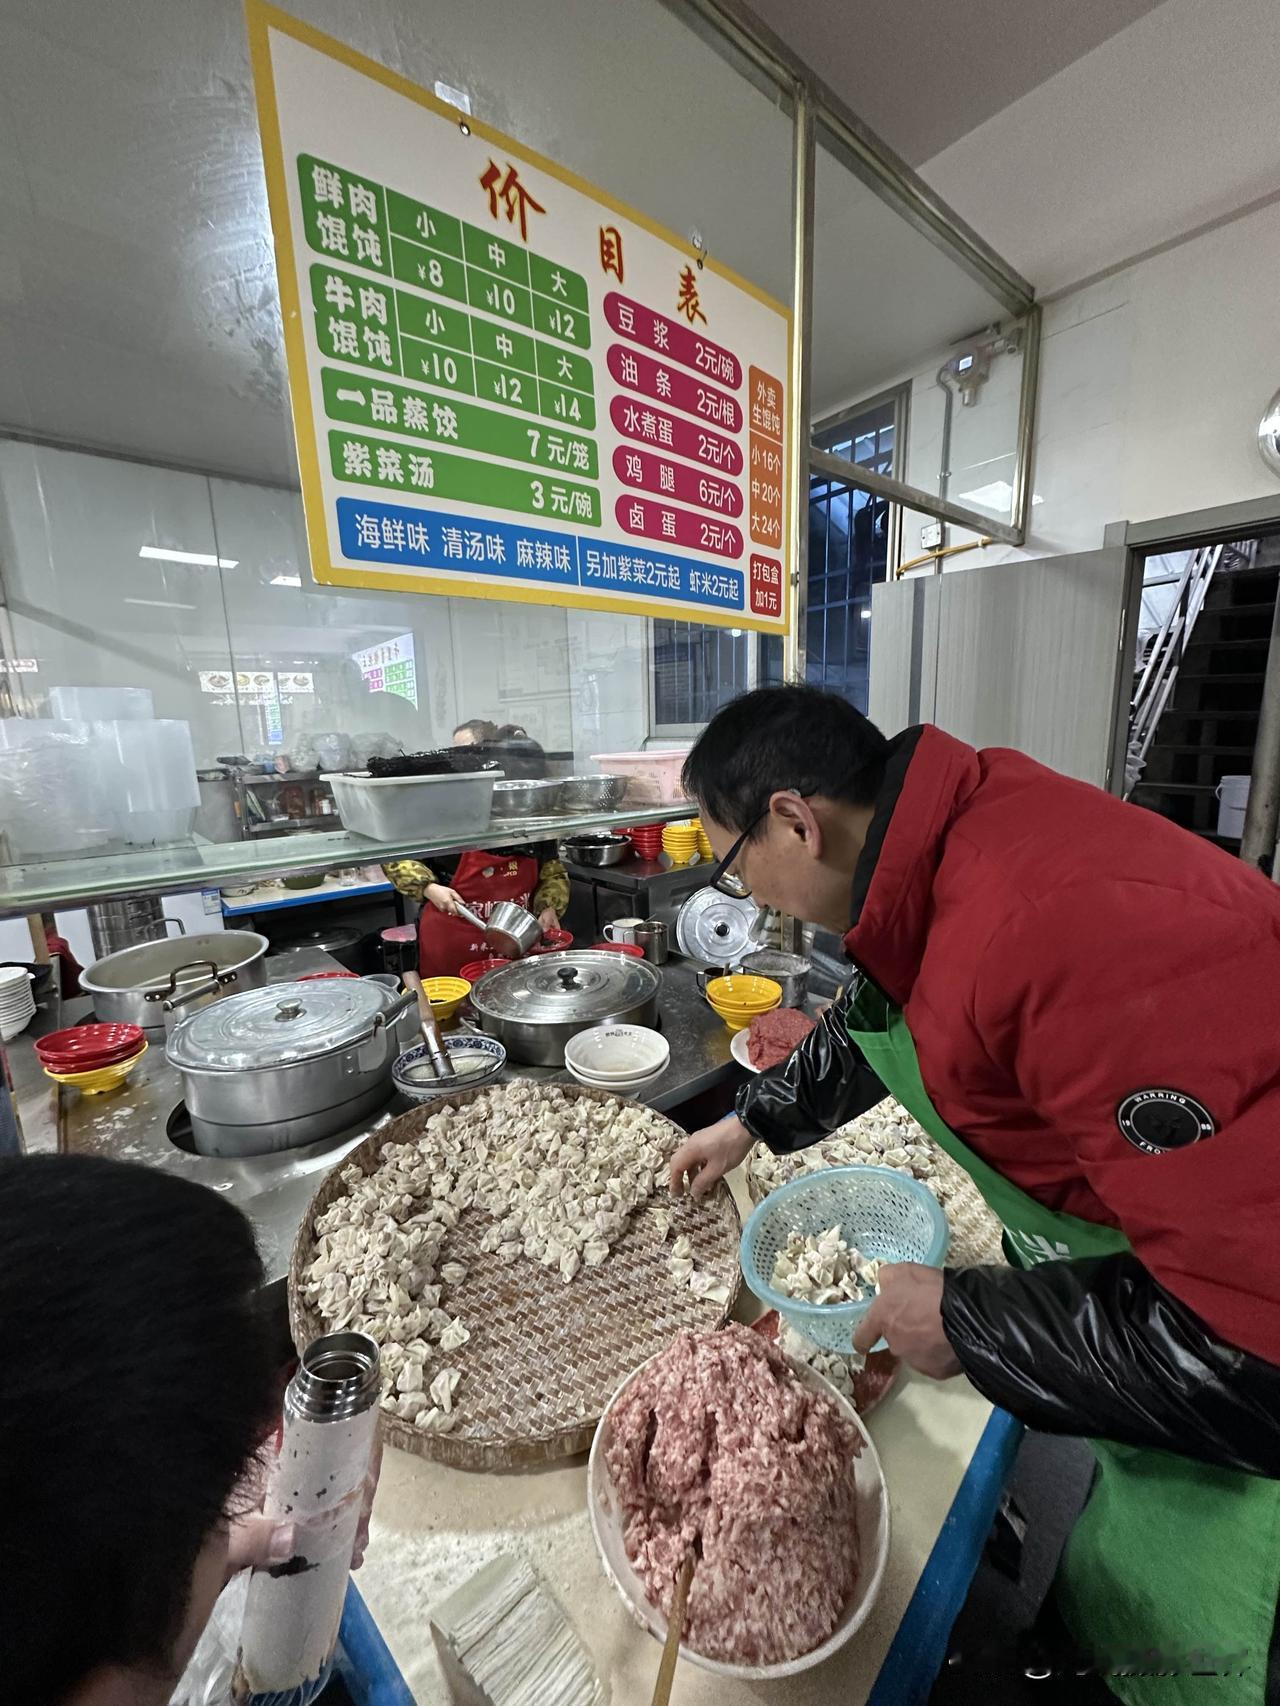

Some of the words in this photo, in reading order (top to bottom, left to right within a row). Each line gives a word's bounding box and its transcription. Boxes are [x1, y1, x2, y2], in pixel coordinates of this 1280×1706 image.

[312, 164, 378, 225] 鲜肉
[316, 210, 383, 267] 馄饨
[416, 211, 437, 239] 小
[488, 242, 506, 269] 中
[551, 271, 568, 297] 大
[325, 274, 388, 326] 牛肉
[418, 259, 444, 288] ¥8
[486, 283, 516, 315] ¥10
[549, 309, 576, 340] ¥12
[328, 316, 393, 367] 馄饨
[425, 308, 446, 335] 小
[495, 333, 513, 359] 中
[557, 355, 574, 381] 大
[695, 342, 735, 384] 2元/碗
[421, 352, 458, 385] ¥10
[493, 373, 523, 404] ¥12
[554, 393, 582, 422] ¥14
[696, 388, 736, 429] 2元/根
[757, 380, 776, 411] 外卖
[336, 387, 459, 440] 一品蒸饺
[623, 404, 674, 447] 水煮蛋
[698, 434, 736, 471] 2元/个
[752, 405, 781, 436] 生馄饨
[342, 440, 435, 489] 紫菜汤
[699, 478, 736, 513] 6元/个
[354, 513, 431, 555] 海鲜味
[441, 525, 507, 565] 清汤味
[516, 538, 572, 574] 麻辣味
[700, 523, 736, 556] 2元/个
[586, 550, 681, 591] 另加紫菜2元起
[689, 568, 739, 602] 虾米2元起
[752, 560, 779, 586] 打包盒
[755, 588, 778, 611] 加1元
[1139, 1141, 1167, 1155] FRO
